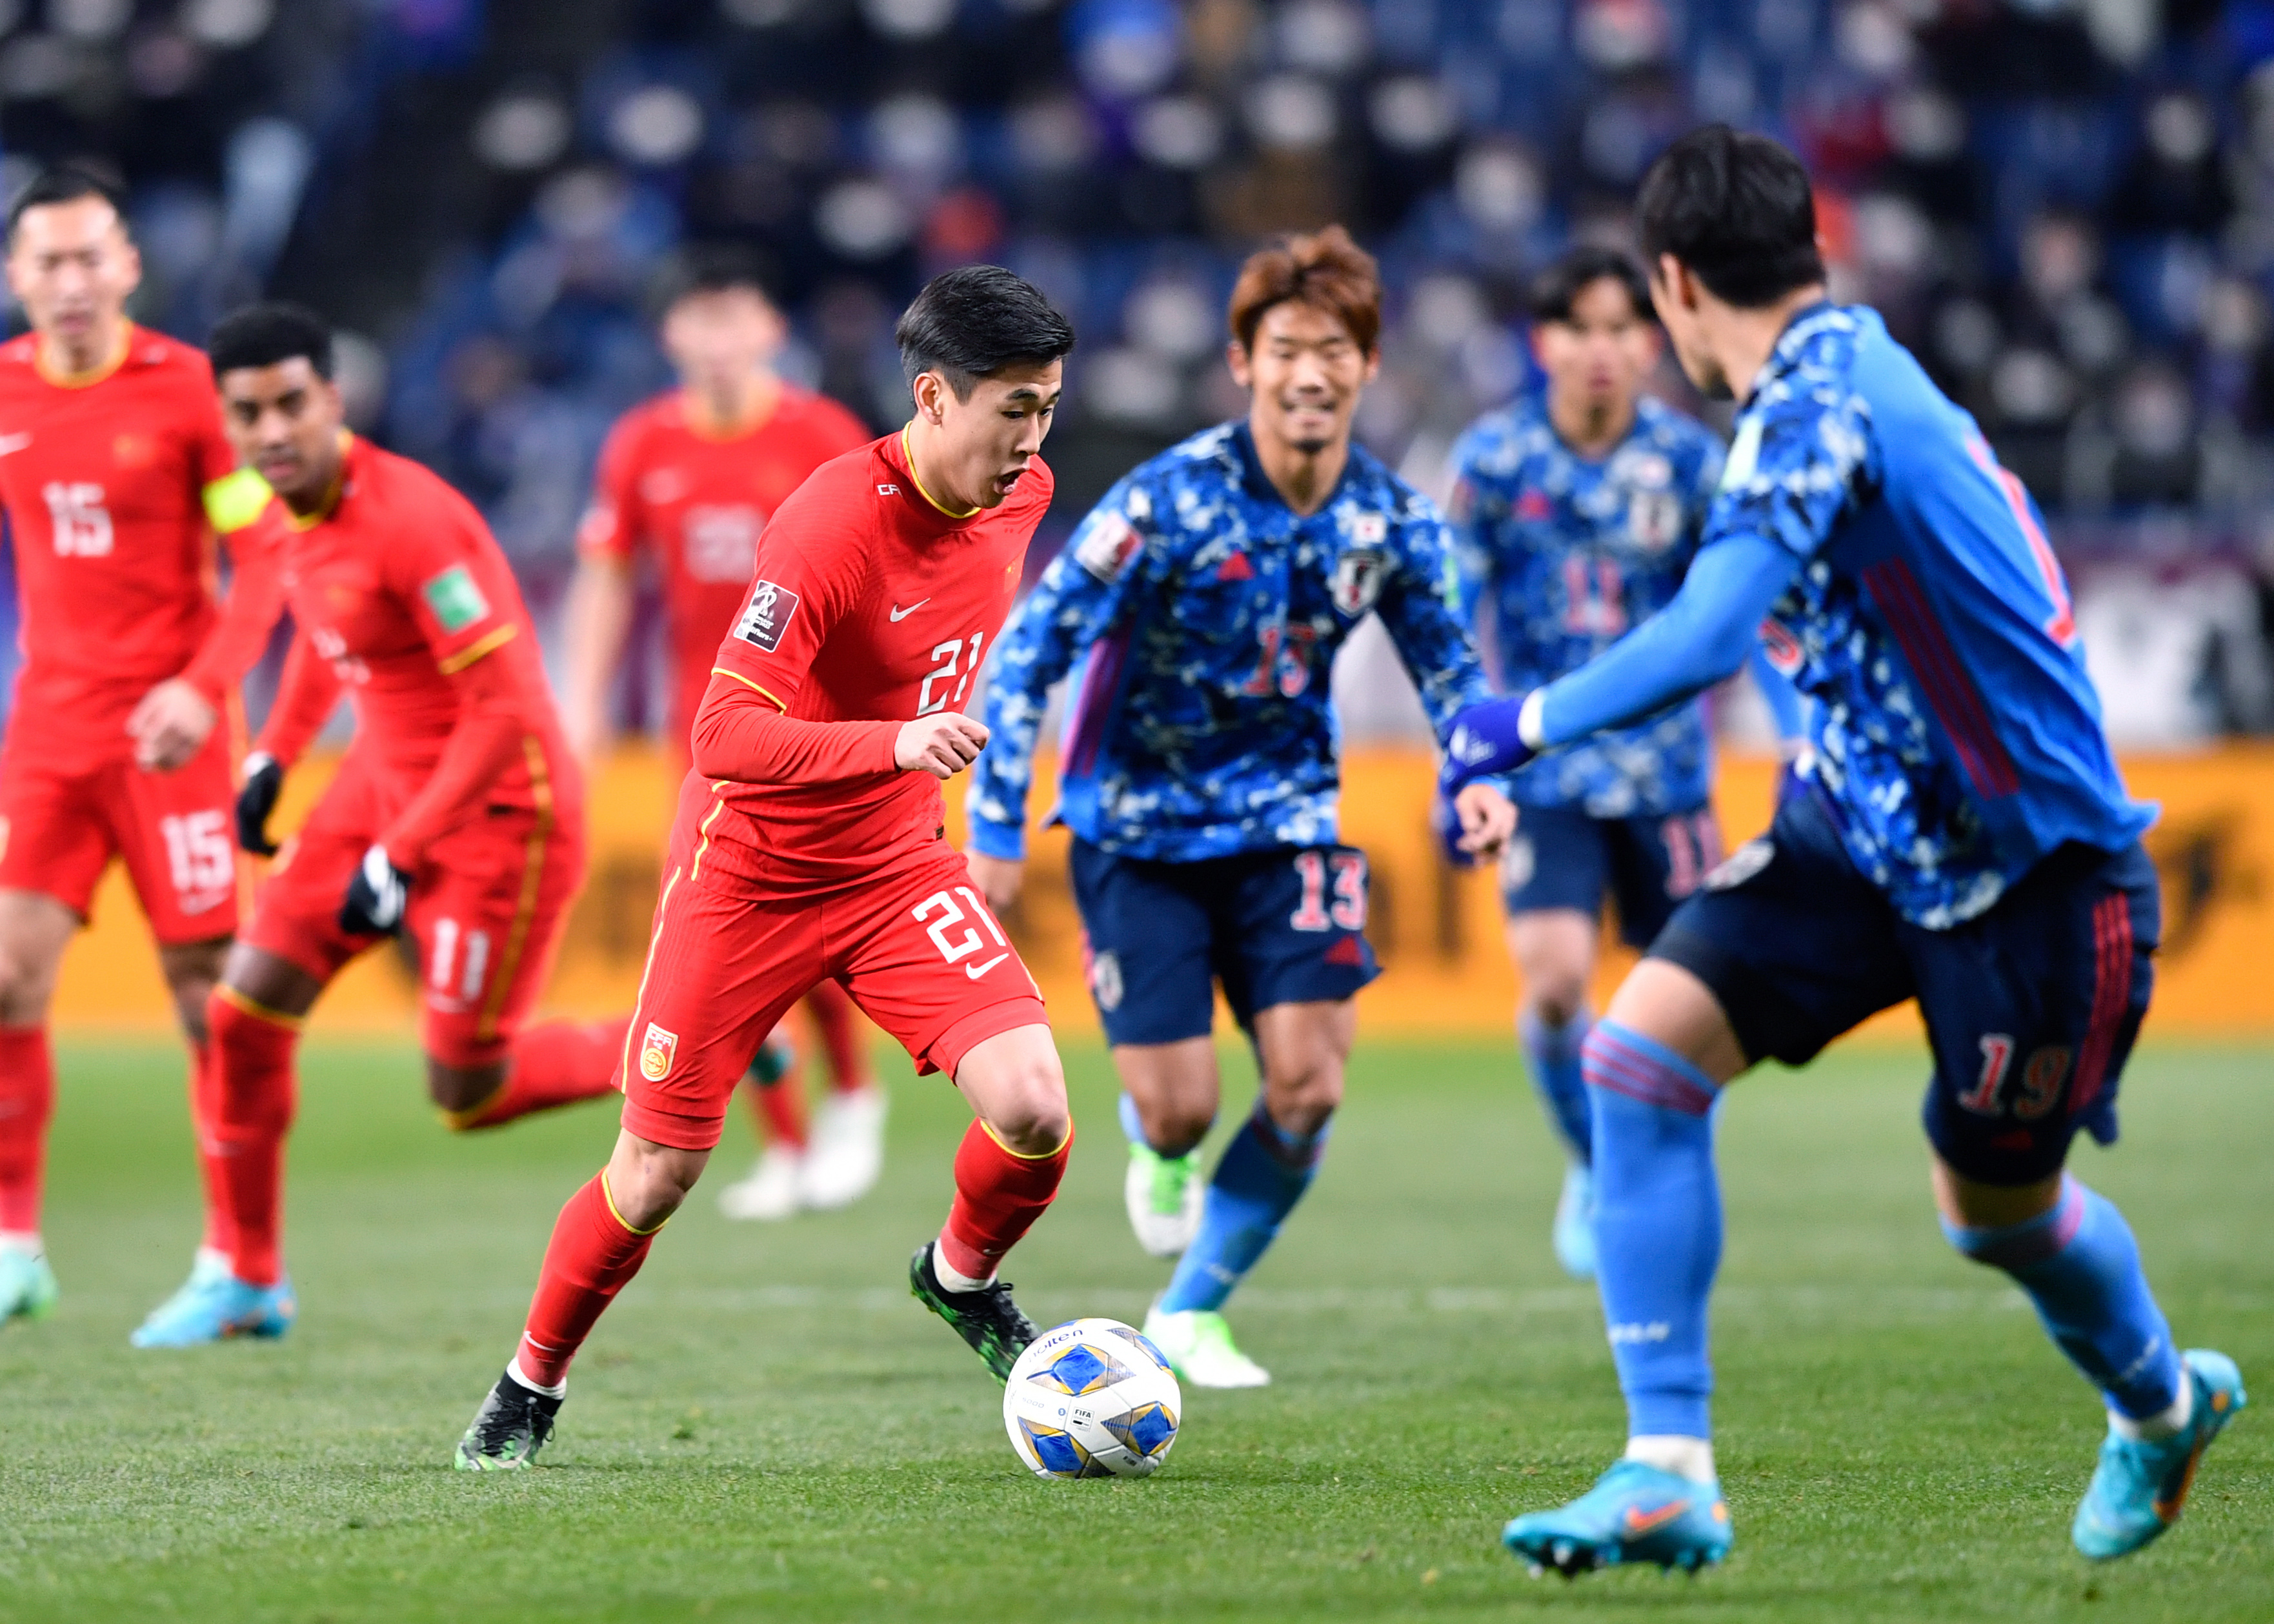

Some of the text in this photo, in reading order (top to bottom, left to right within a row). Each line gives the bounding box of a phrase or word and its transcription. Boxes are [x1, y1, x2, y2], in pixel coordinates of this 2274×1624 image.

[42, 481, 113, 557] 15
[916, 631, 983, 716] 21
[161, 809, 234, 892] 15
[911, 887, 1006, 964] 21
[1291, 852, 1367, 930] 13
[434, 917, 490, 1001] 11
[1957, 1033, 2070, 1118] 19
[1075, 1409, 1091, 1418] FIFA
